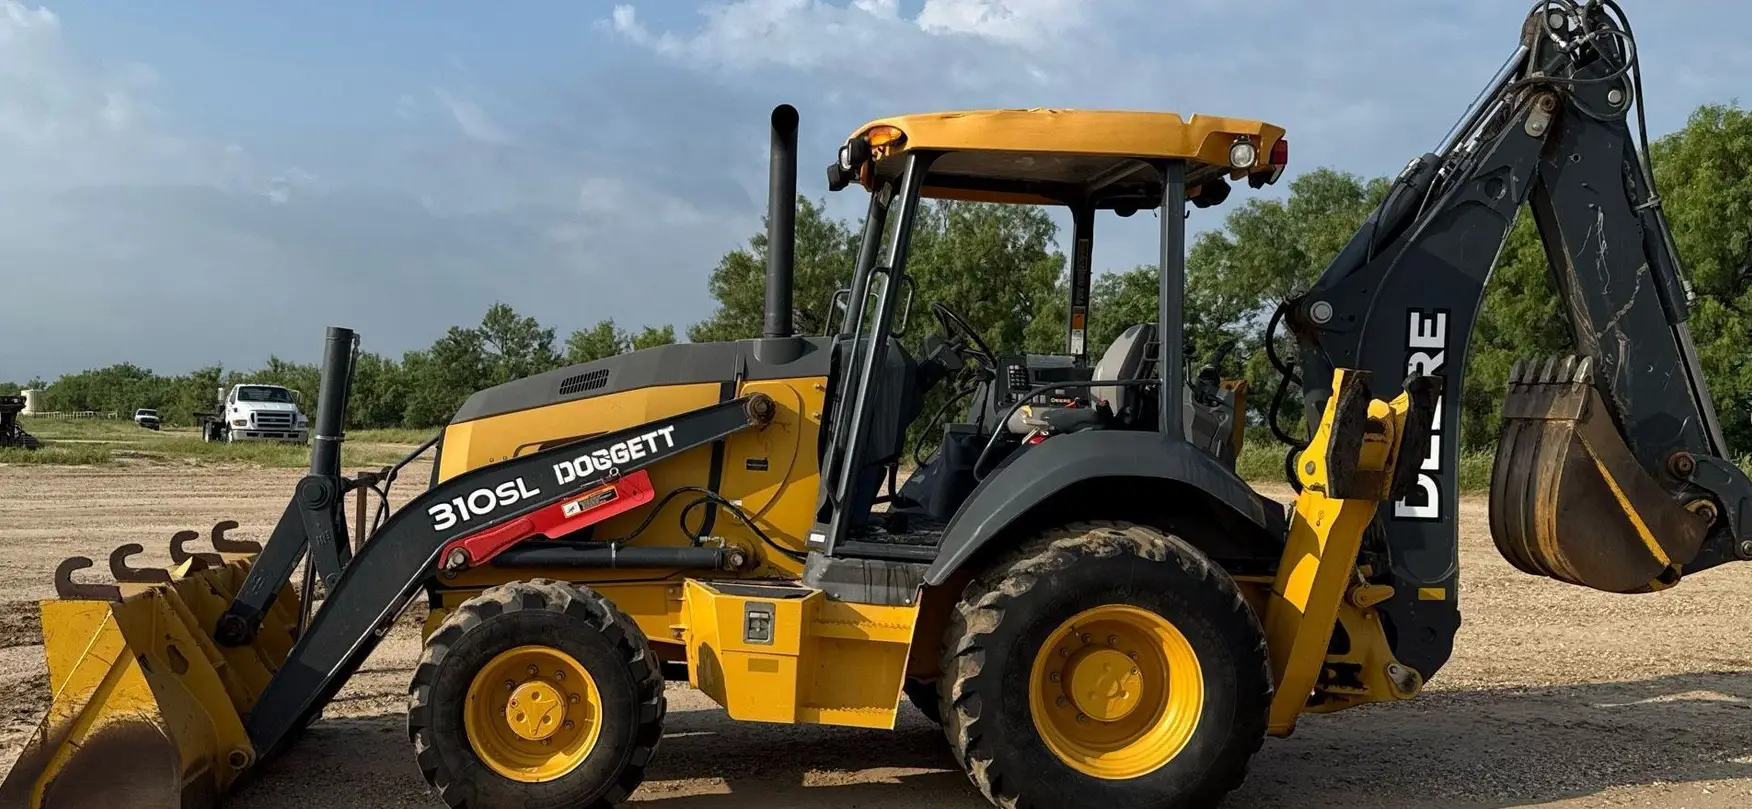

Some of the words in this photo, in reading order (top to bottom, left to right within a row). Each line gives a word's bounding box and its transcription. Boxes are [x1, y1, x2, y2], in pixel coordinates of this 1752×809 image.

[428, 478, 540, 531] 310SL
[553, 425, 674, 485] DOGGETT
[1395, 312, 1446, 518] DRE
